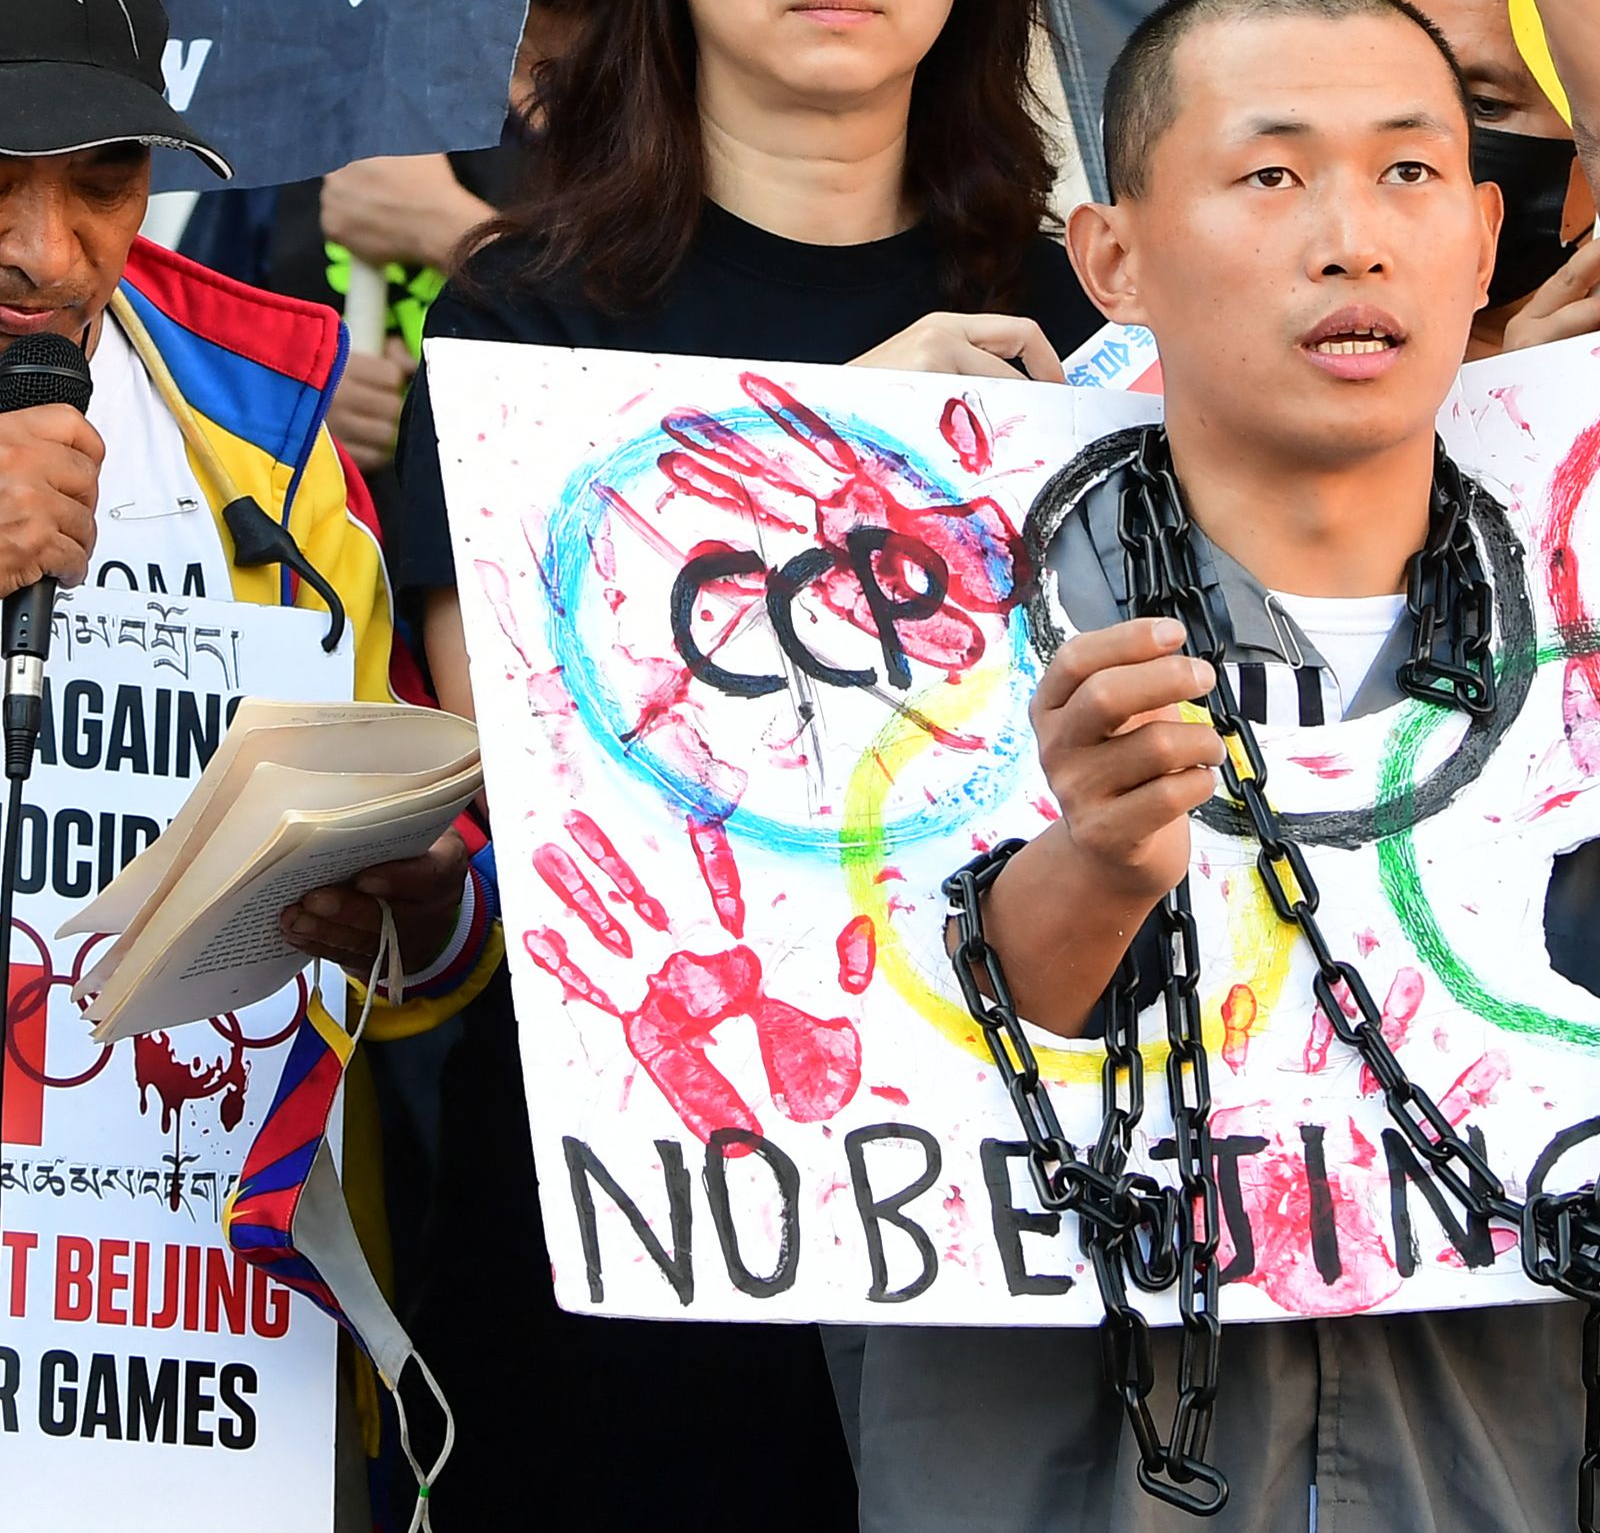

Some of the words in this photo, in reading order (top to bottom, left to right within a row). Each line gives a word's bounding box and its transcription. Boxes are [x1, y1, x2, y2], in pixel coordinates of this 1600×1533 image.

[670, 525, 949, 699] CCP
[562, 1122, 801, 1308] NO
[53, 1236, 291, 1340] BEIJING
[37, 1348, 259, 1450] GAMES
